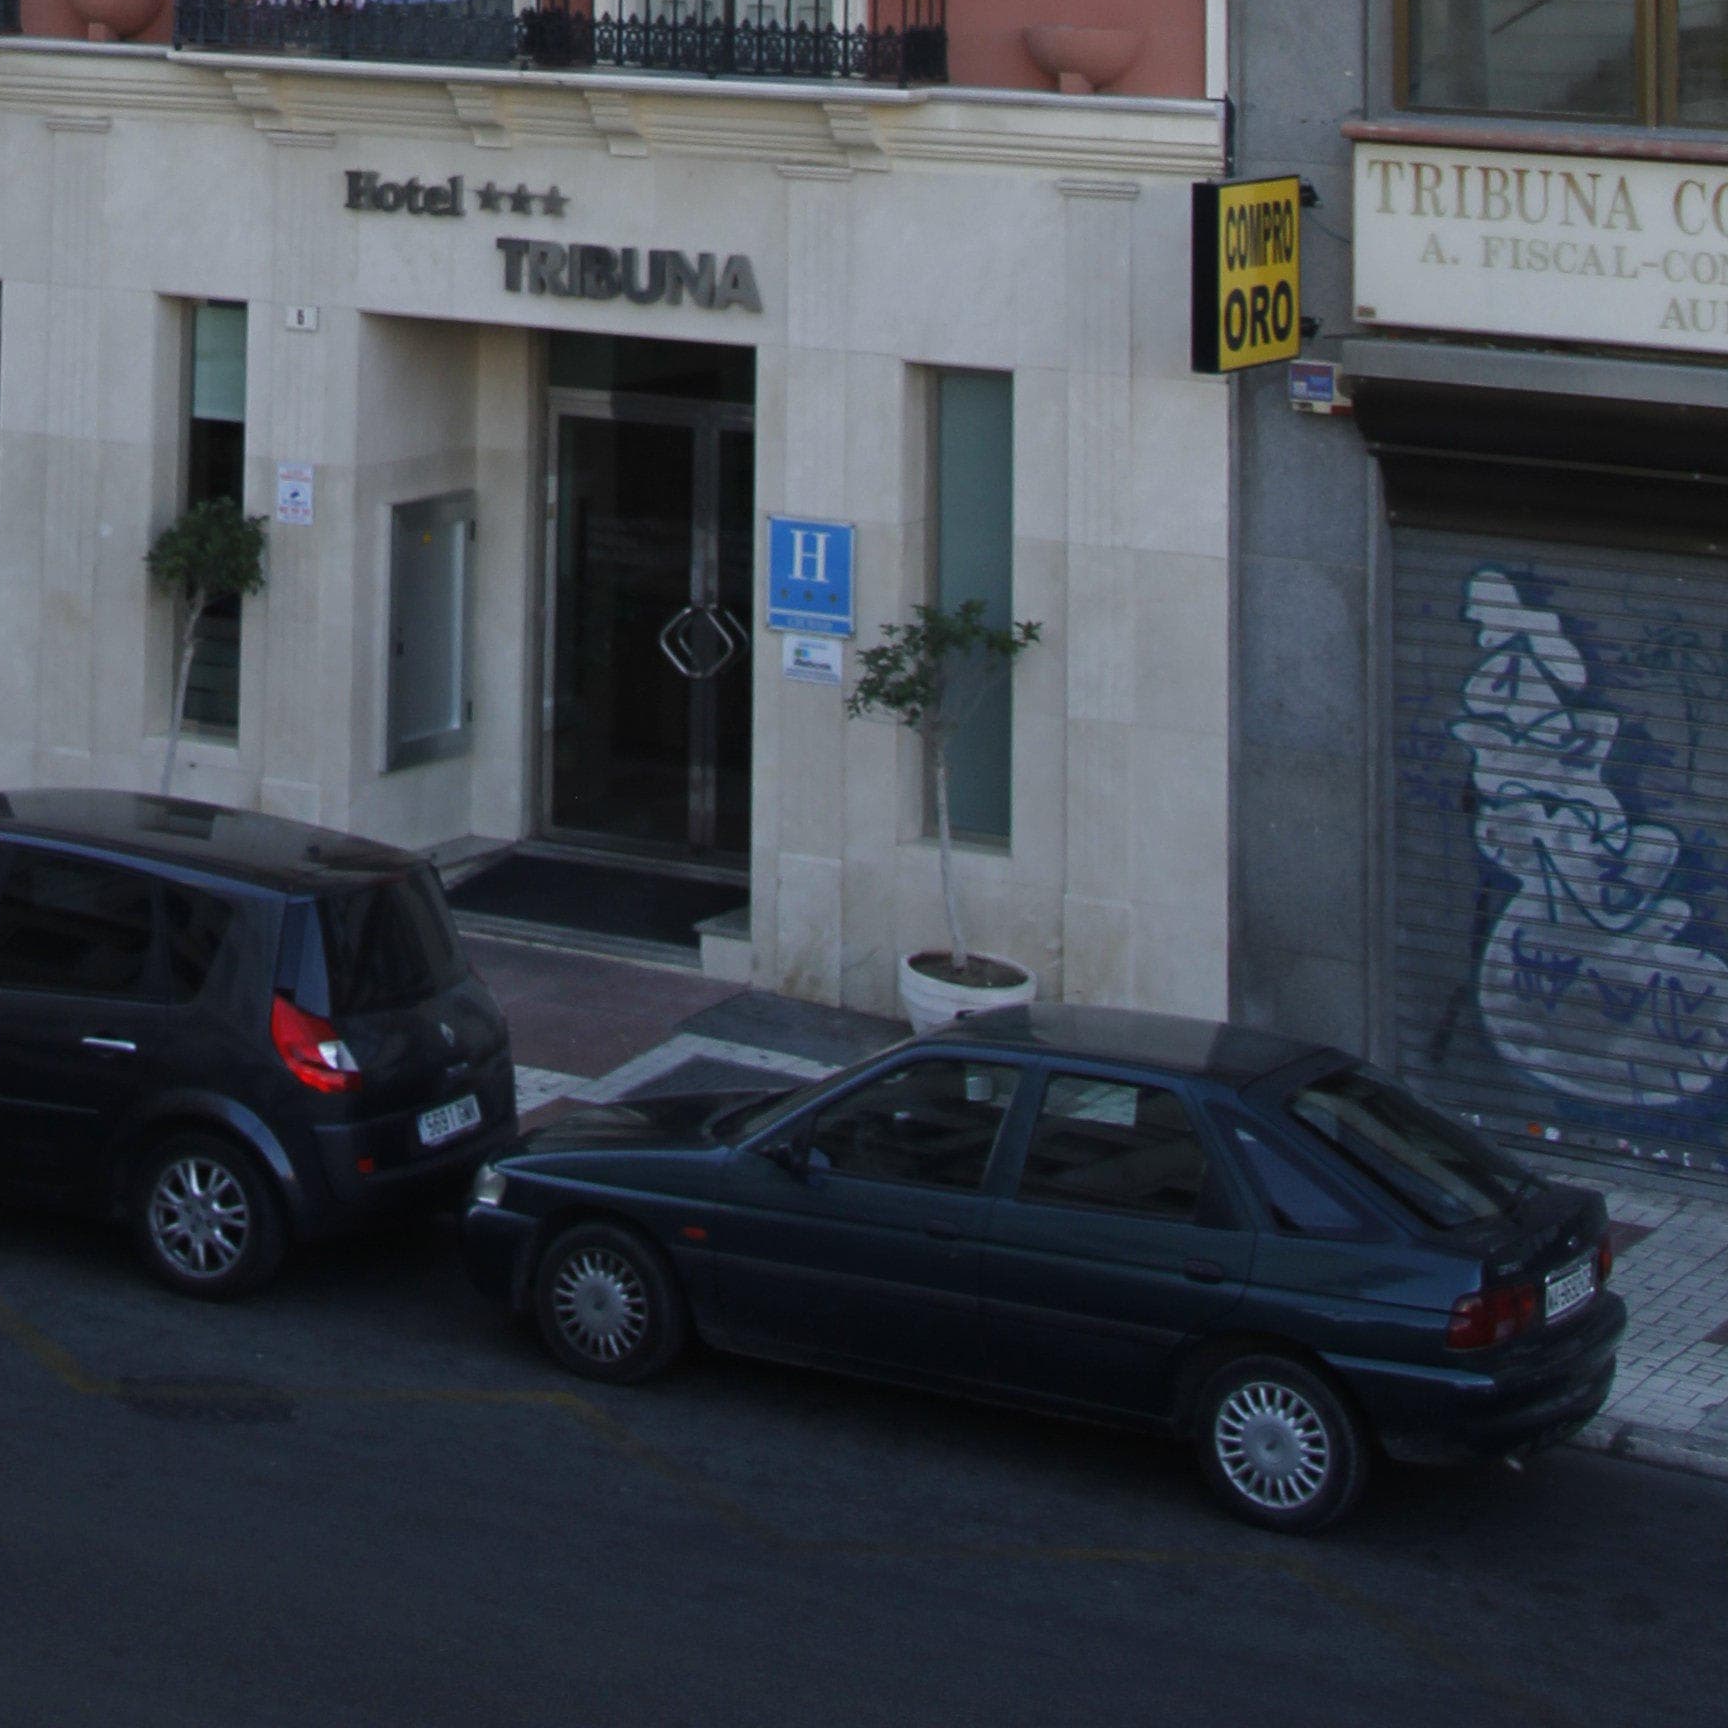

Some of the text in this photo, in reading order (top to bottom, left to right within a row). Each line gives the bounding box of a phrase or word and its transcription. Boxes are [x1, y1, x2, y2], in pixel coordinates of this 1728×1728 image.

[344, 169, 466, 218] Hotel
[1367, 158, 1644, 233] TRIBUNA
[1225, 198, 1294, 272] COMPRO
[1419, 231, 1460, 266] A.
[495, 236, 764, 314] TRIBUNA
[1224, 279, 1294, 352] ORO
[787, 528, 831, 583] H
